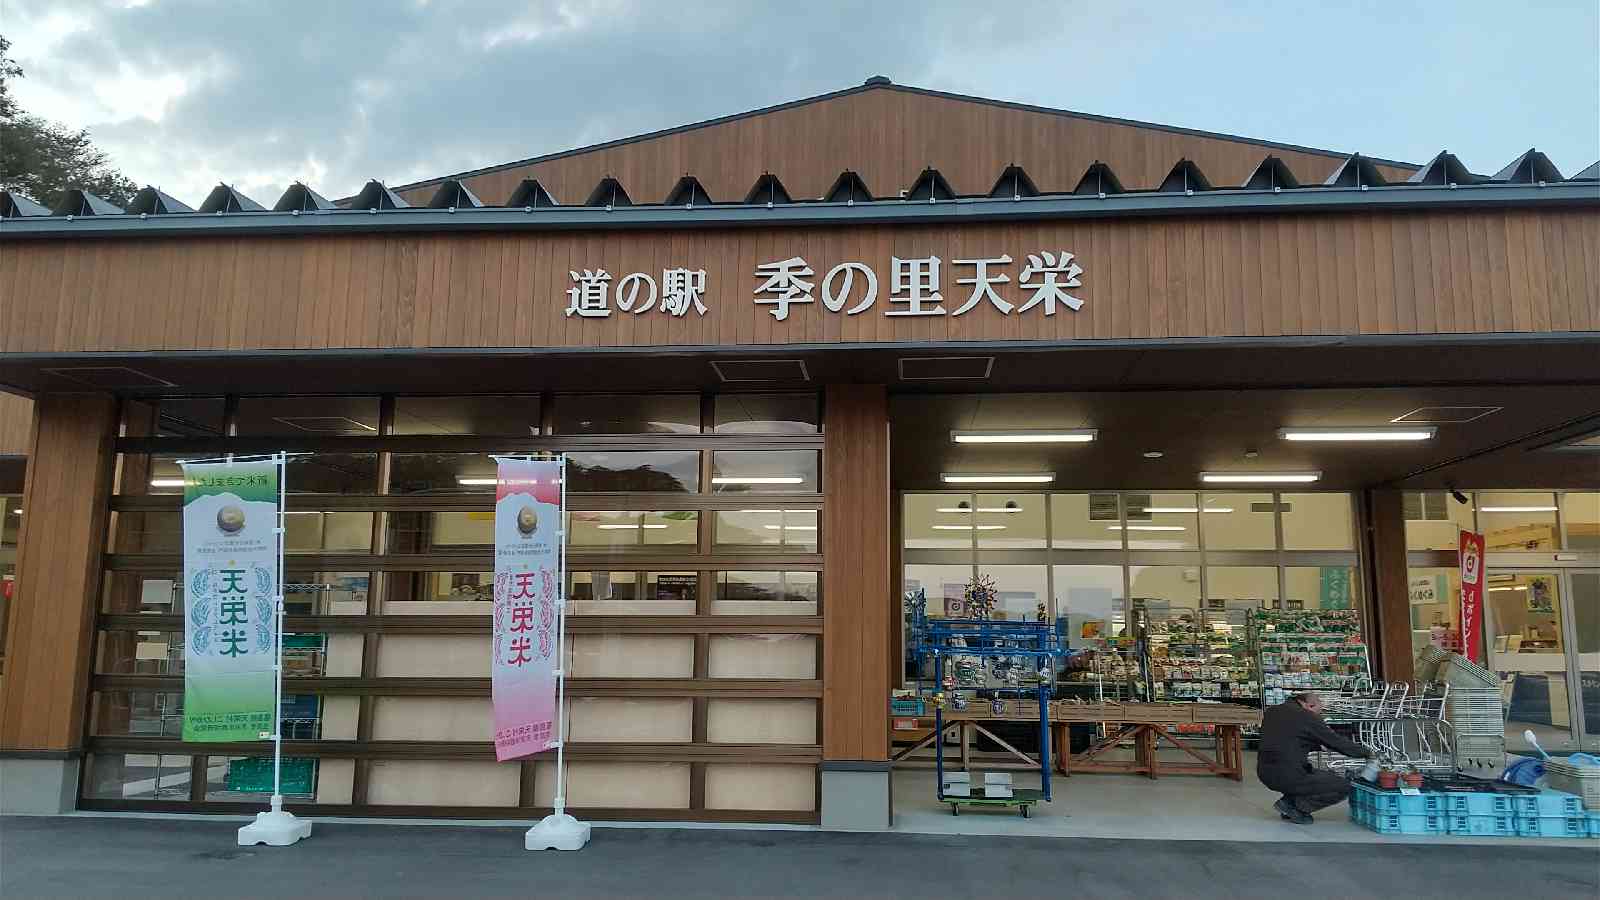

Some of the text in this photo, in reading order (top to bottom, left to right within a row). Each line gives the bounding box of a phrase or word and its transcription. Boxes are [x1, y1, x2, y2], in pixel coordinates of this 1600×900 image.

[566, 250, 1084, 321] 道の駅 季の里天栄
